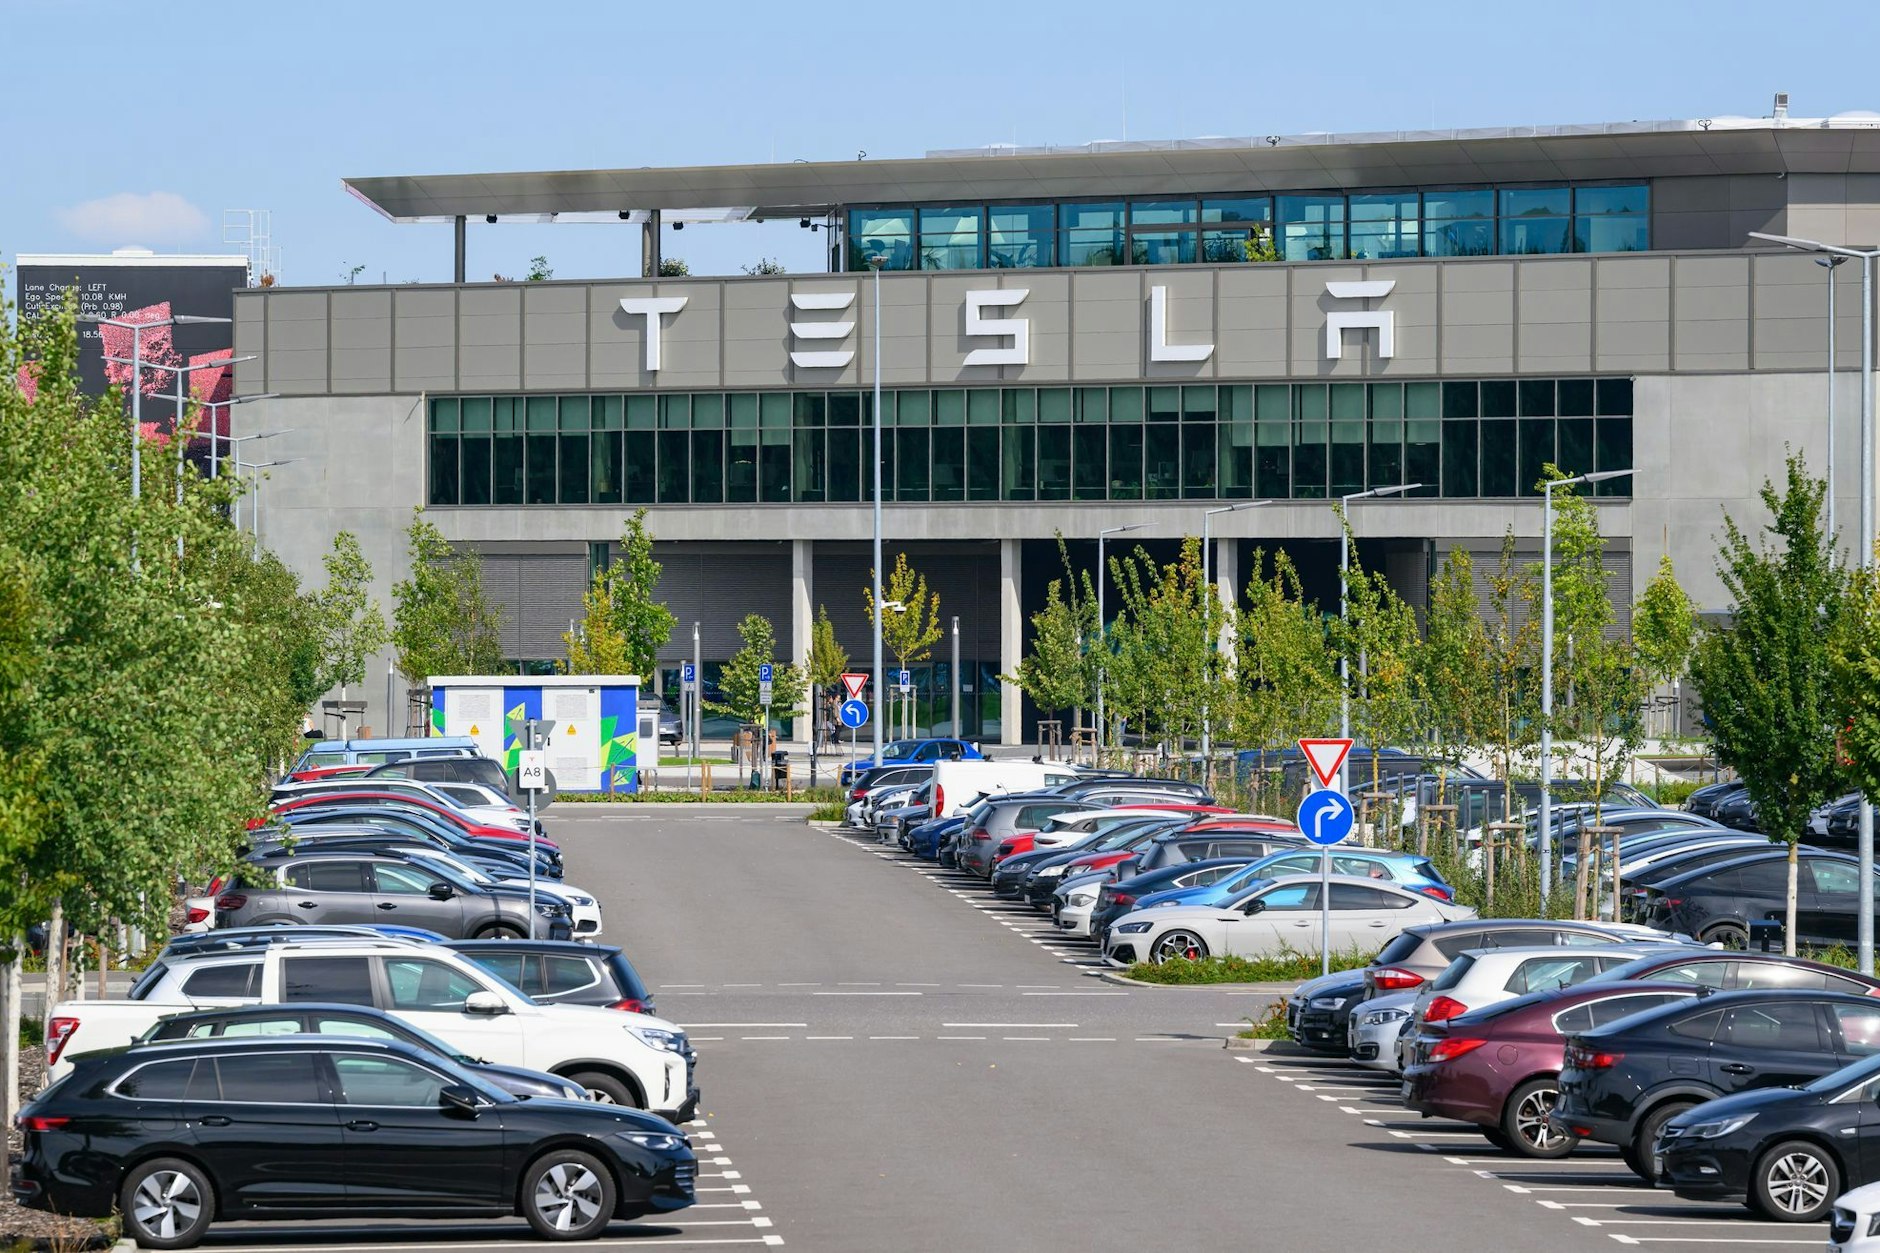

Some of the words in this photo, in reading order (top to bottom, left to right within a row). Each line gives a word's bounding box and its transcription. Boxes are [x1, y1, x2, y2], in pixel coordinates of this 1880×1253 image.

[25, 293, 40, 302] Ego
[81, 293, 103, 301] 10.08
[81, 302, 97, 311] (Prb
[103, 302, 123, 311] 0.98)
[620, 280, 1397, 372] TESLA
[523, 767, 541, 777] A8
